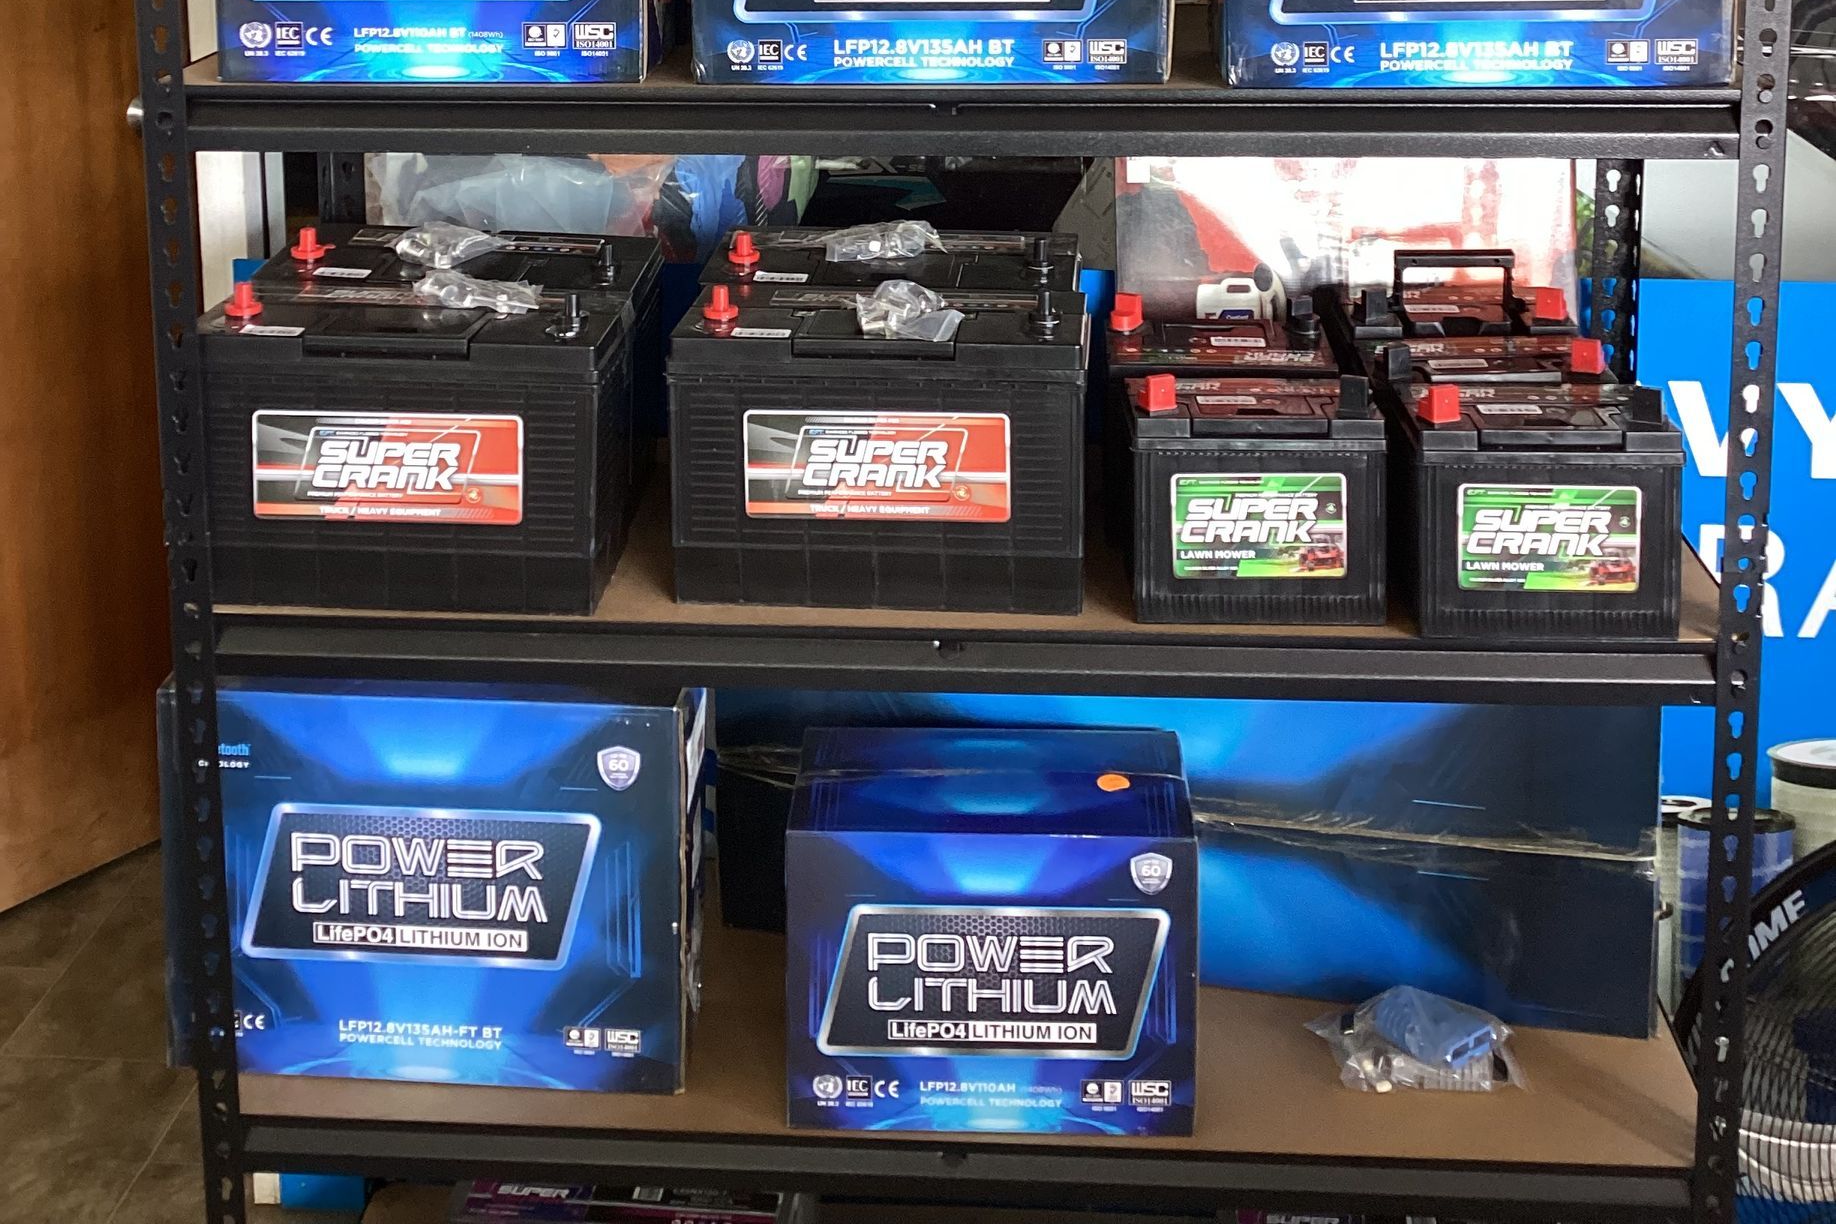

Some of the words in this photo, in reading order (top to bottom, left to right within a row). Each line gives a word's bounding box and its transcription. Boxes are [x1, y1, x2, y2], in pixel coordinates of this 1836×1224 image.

[276, 28, 299, 39] IEC
[759, 44, 779, 56] IEC
[833, 39, 983, 55] LFP12.8V135AH
[988, 39, 1015, 54] BT
[1304, 46, 1326, 58] IEC
[833, 56, 918, 68] POWERCELL
[920, 56, 1015, 68] TECHNOLOGY
[318, 440, 462, 467] SUPER
[808, 439, 949, 464] SUPER
[311, 464, 458, 490] CRANK
[802, 463, 947, 488] CRANK
[847, 505, 878, 515] HEAVY
[1185, 498, 1319, 521] SUPER
[1472, 509, 1612, 533] SUPER
[1180, 520, 1317, 543] CRANK
[1466, 532, 1609, 556] CRANK
[1180, 550, 1213, 560] LAWN
[1215, 550, 1256, 560] MOWER
[1466, 561, 1500, 571] LAWN
[1501, 561, 1545, 572] MOWER
[217, 743, 249, 756] tooth
[609, 760, 629, 771] 60
[291, 832, 545, 880] POWER
[292, 877, 548, 923] LITHIUM
[317, 925, 394, 944] LifePO4
[401, 932, 480, 947] LITHIUM
[487, 932, 522, 948] ION
[867, 932, 1115, 974] POWER
[868, 976, 1117, 1014] LITHIUM
[338, 1019, 478, 1038] LFP12.8V135AH-FT
[482, 1027, 503, 1039] BT
[891, 1022, 967, 1039] LifePO4
[973, 1024, 1051, 1039] LITHIUM
[1058, 1025, 1092, 1040] ION
[339, 1033, 414, 1046] POWERCELL
[418, 1036, 502, 1050] TECHNOLOGY
[847, 1079, 868, 1092] IEC
[920, 1096, 986, 1106] POWERCELL
[988, 1097, 1063, 1108] TECHNOLOGY
[497, 1185, 570, 1199] SUPER
